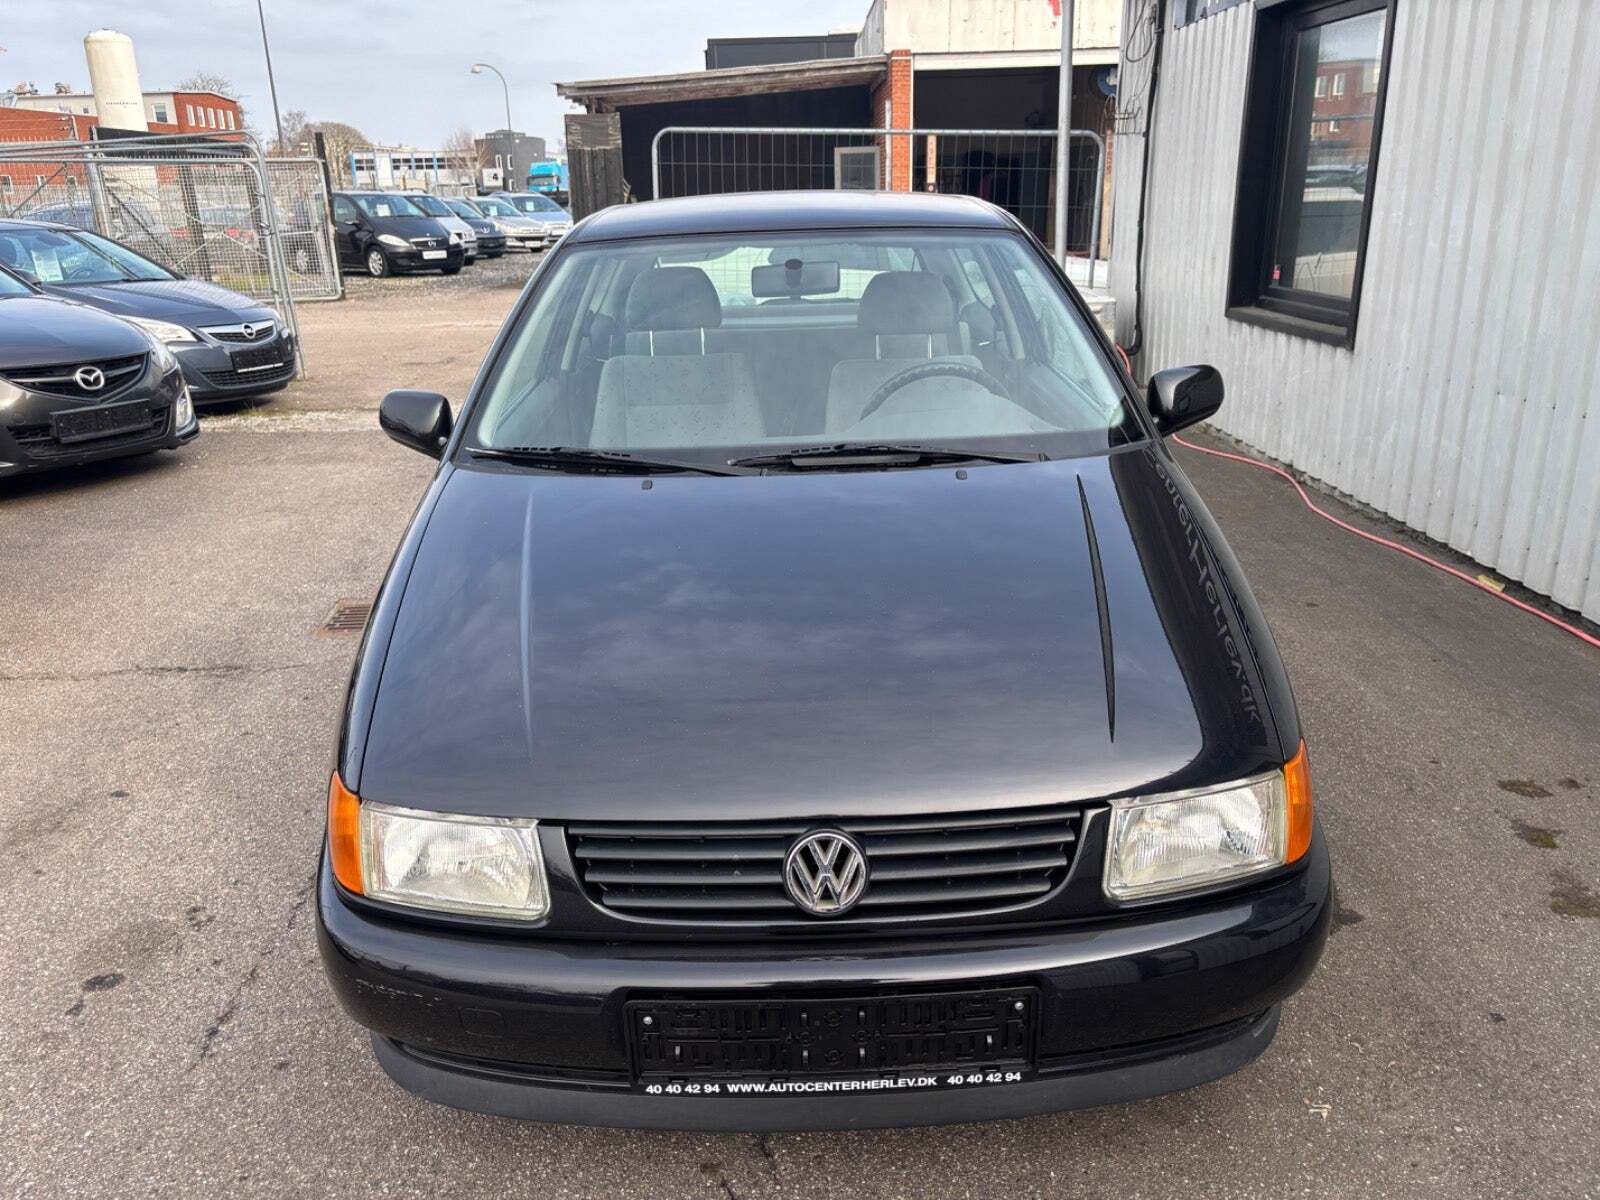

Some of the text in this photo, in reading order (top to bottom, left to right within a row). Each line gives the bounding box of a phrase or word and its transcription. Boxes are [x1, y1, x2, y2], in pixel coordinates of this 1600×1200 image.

[787, 833, 866, 913] VW
[645, 1071, 1022, 1095] 40 40 42 94 WWW.AUTOCENTERHERLEV.DK 40 40 42 94
